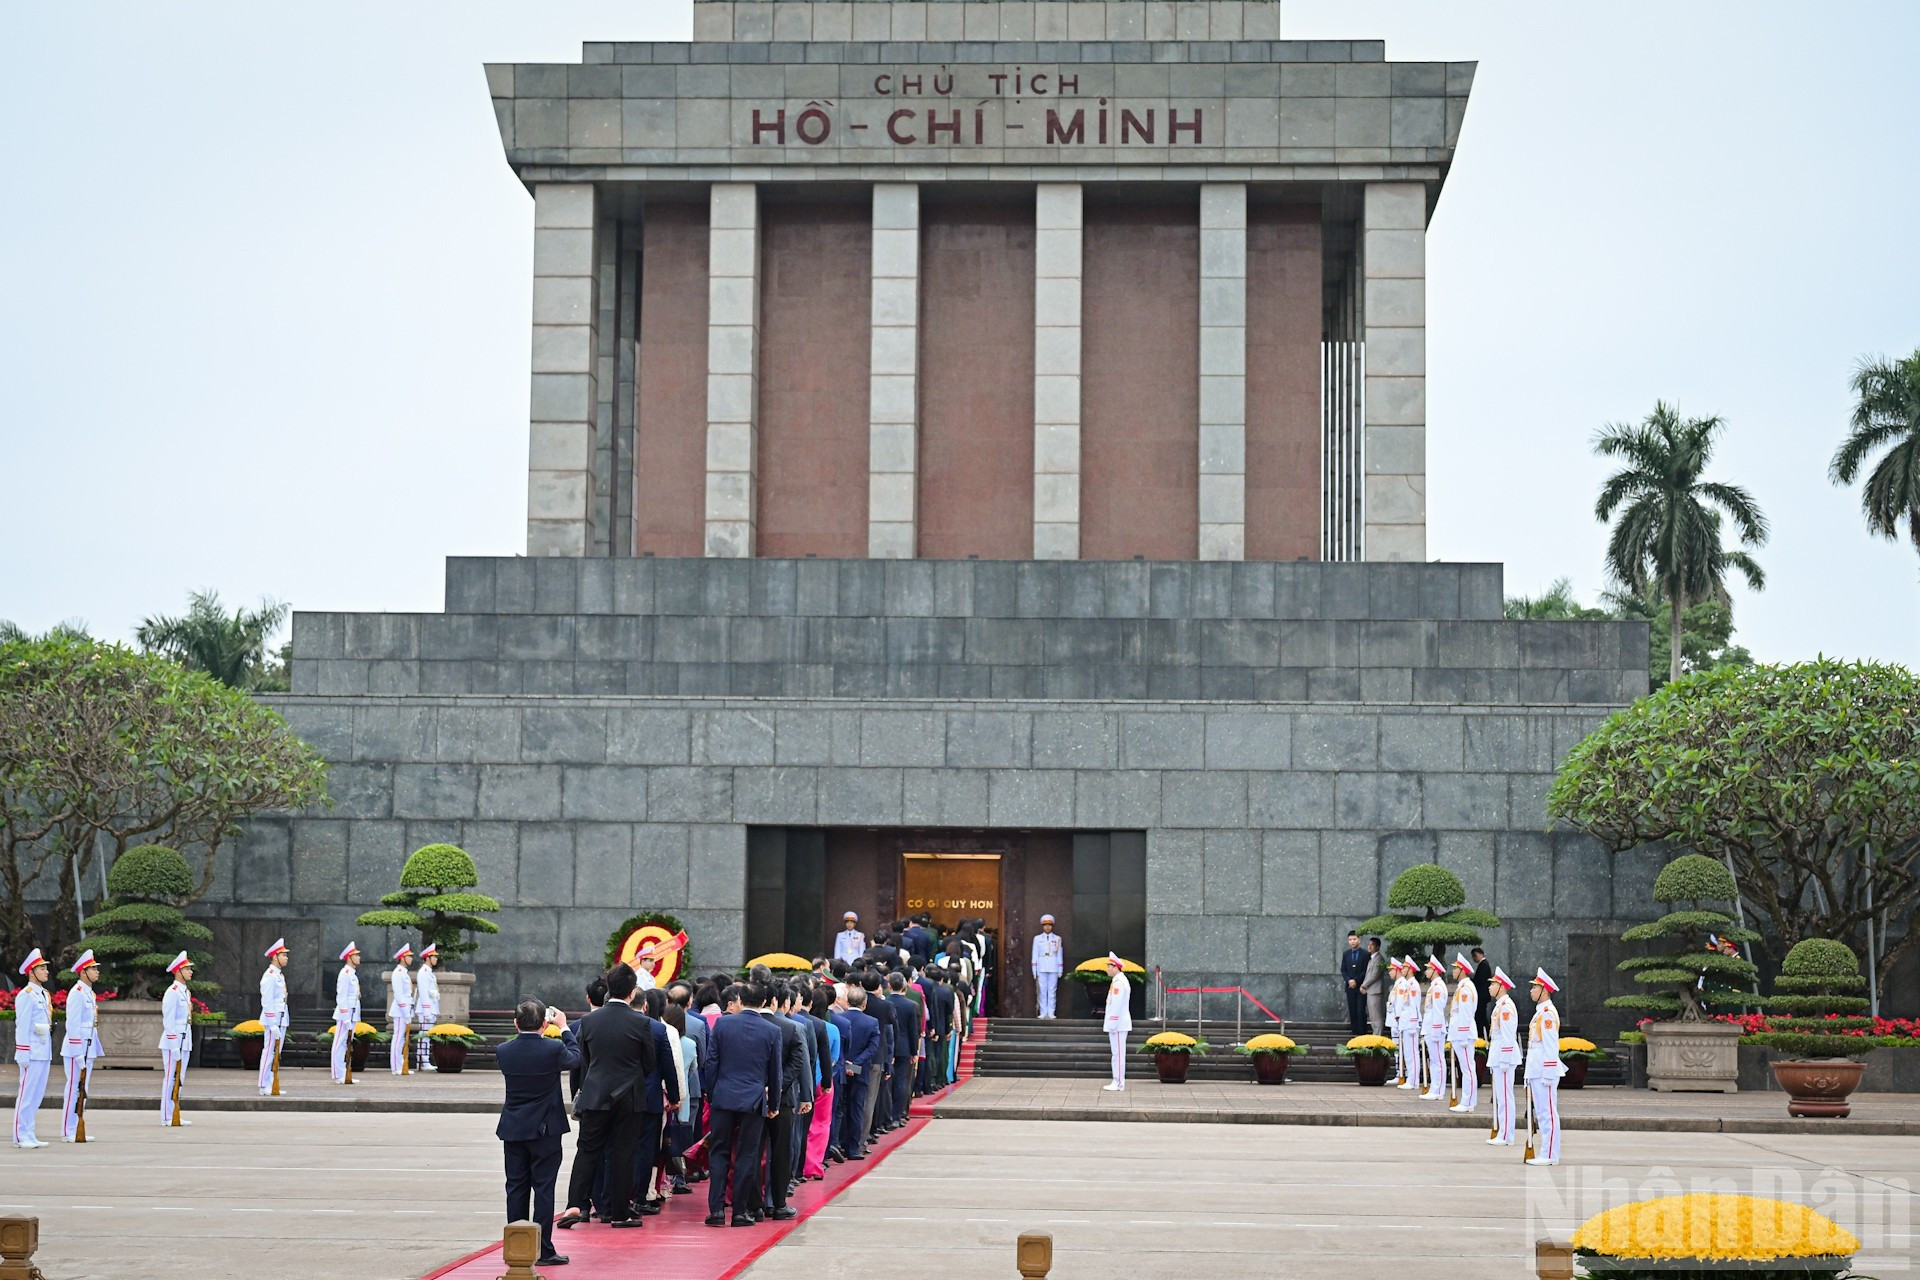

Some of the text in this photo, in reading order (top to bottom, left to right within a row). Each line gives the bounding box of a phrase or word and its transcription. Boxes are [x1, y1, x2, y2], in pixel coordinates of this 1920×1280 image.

[874, 65, 953, 95] CHỦ
[752, 100, 834, 145] HỒ
[887, 99, 989, 145] CHÍ
